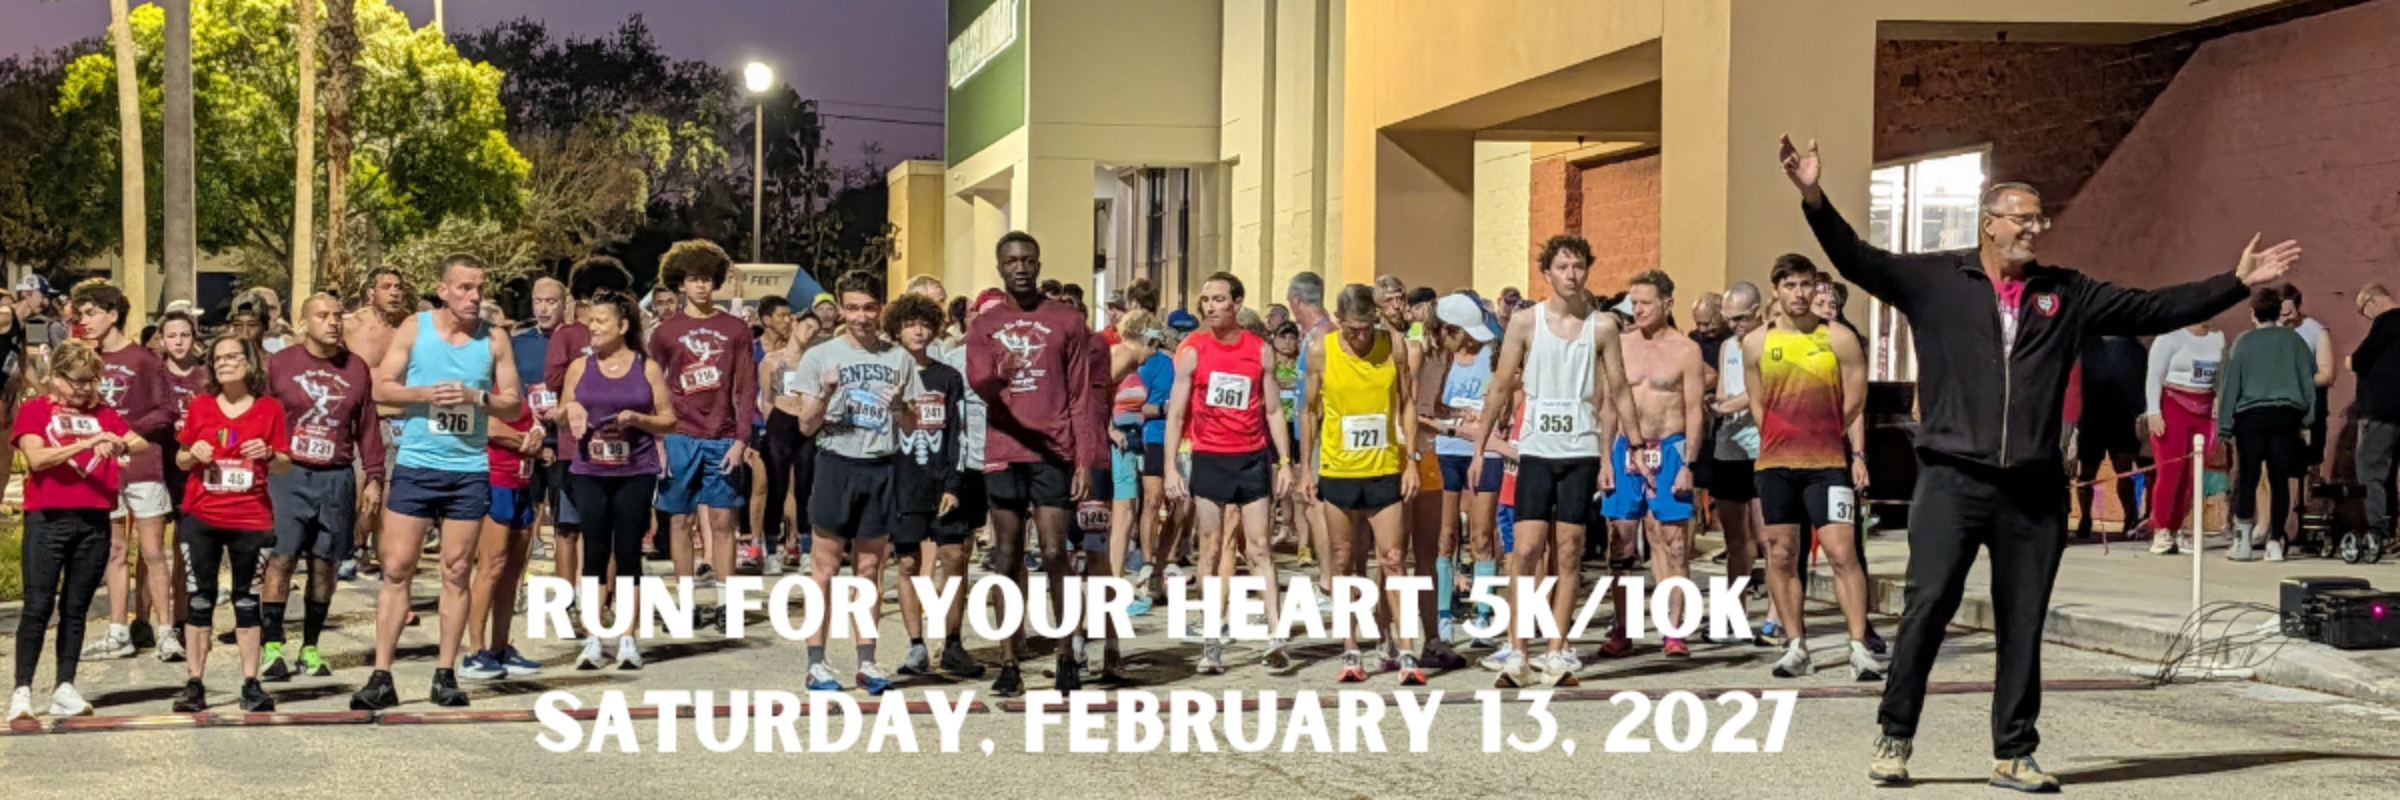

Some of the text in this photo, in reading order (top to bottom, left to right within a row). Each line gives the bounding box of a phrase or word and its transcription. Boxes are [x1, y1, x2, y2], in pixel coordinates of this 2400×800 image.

[750, 275, 781, 286] FEET
[1213, 387, 1243, 407] 361
[436, 412, 469, 433] 376
[1539, 414, 1573, 433] 353
[1351, 429, 1379, 449] 727
